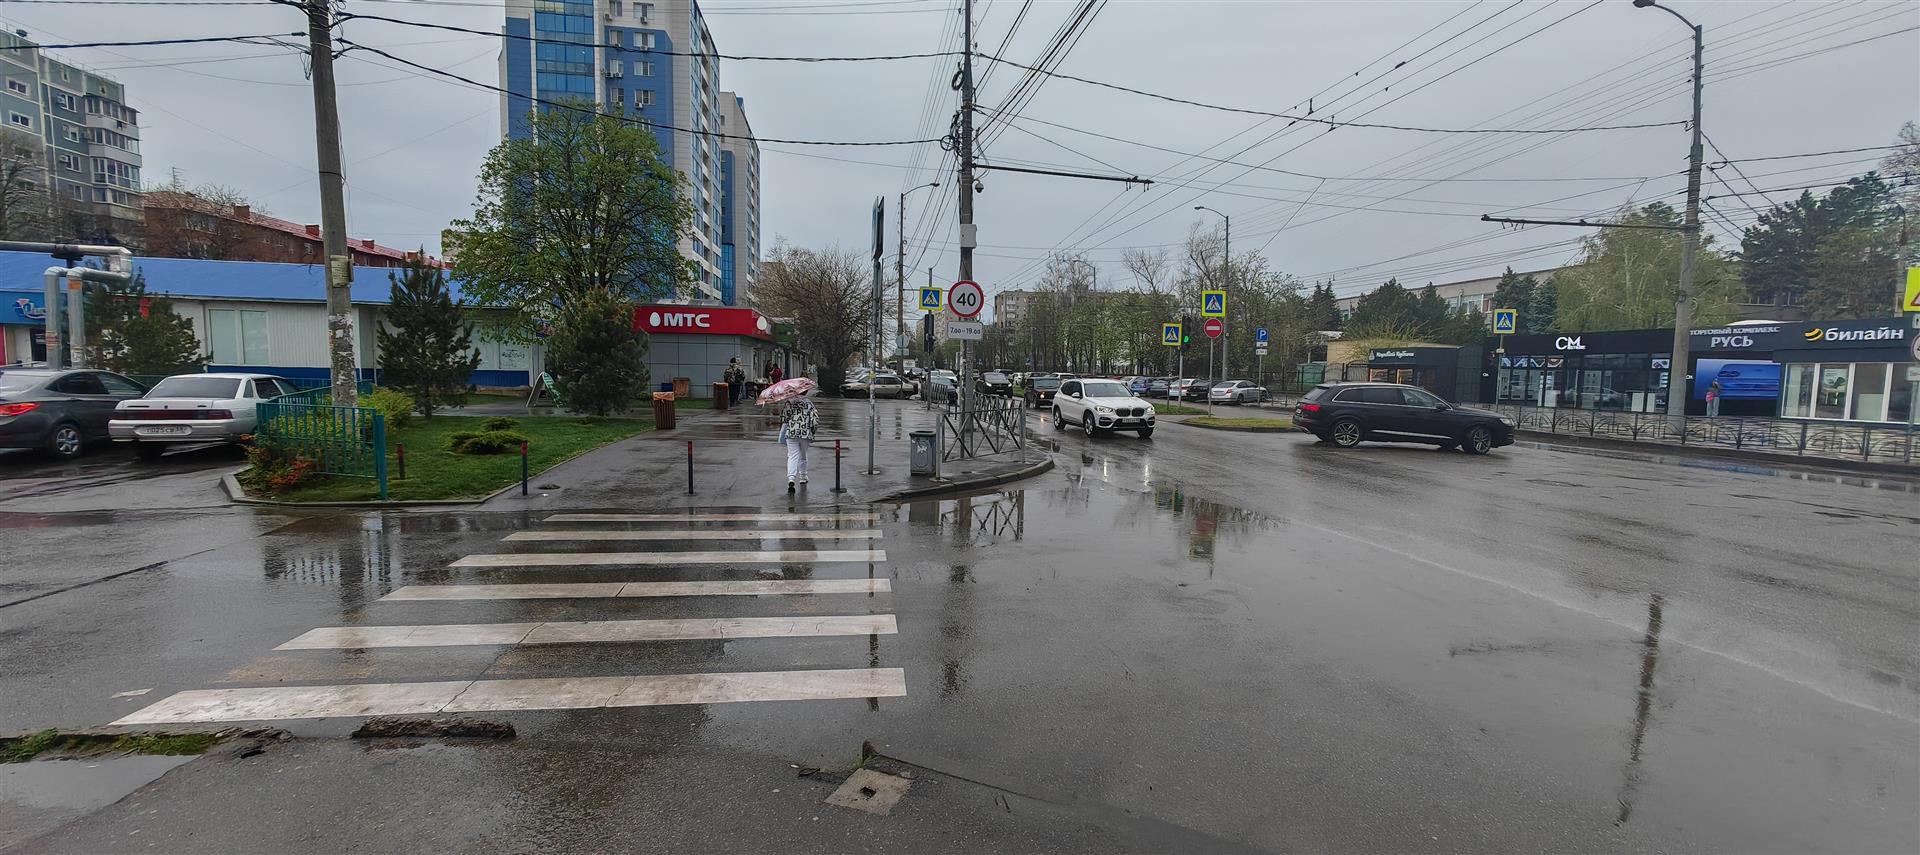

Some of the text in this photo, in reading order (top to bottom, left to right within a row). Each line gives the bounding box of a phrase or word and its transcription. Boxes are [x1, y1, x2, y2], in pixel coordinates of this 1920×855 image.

[956, 292, 977, 307] 40
[663, 312, 710, 328] МТС
[1260, 330, 1267, 340] P
[1689, 326, 1781, 336] ТОРГОВЫЙ КОМПЛЕКС
[1825, 326, 1905, 341] билайн
[1710, 335, 1754, 348] РУСЬ
